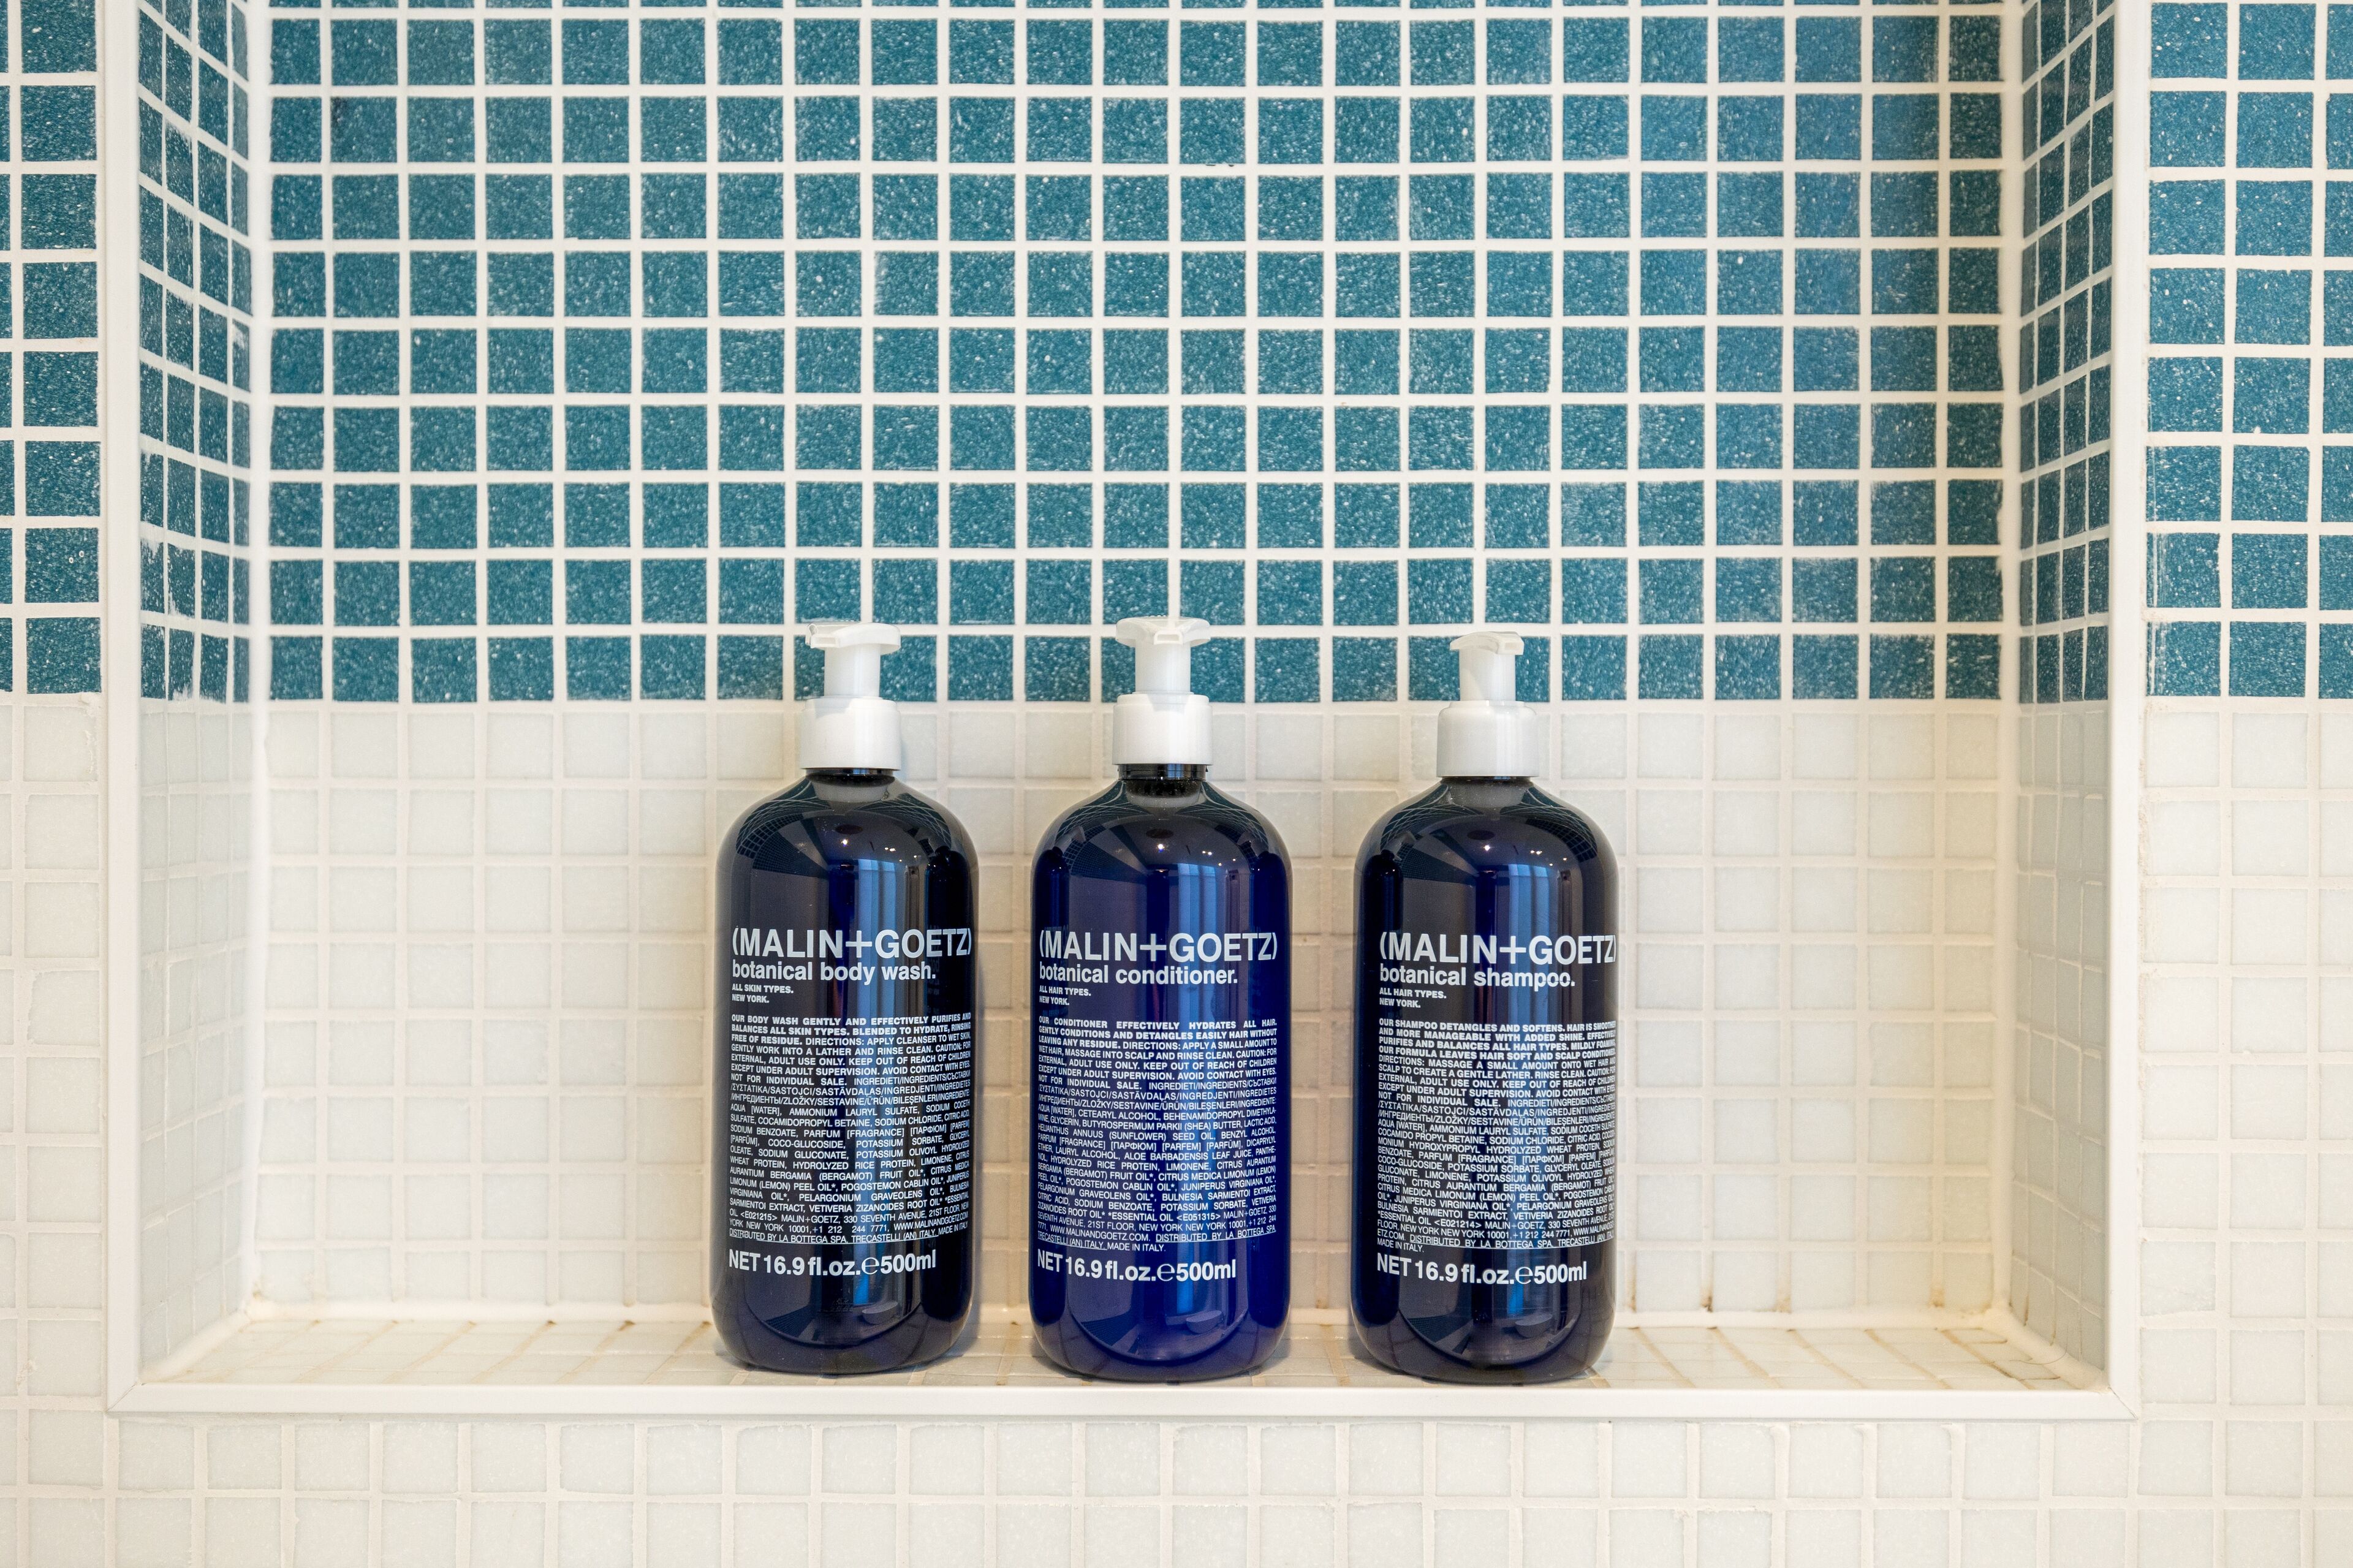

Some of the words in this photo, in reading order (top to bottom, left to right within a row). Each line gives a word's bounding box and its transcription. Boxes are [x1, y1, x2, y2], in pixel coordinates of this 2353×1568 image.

[732, 928, 972, 958] (MALIN+GOETZ)
[1039, 930, 1277, 963] (MALIN+GOETZ)
[1380, 932, 1616, 965] (MALIN+GOETZ)
[732, 960, 813, 980] botanical
[820, 961, 875, 985] body
[881, 960, 936, 980] wash.
[1039, 961, 1108, 983] botanical
[1115, 966, 1238, 985] conditioner.
[1380, 964, 1466, 985] botanical
[1474, 968, 1575, 991] shampoo.
[744, 984, 762, 993] SKIN
[763, 985, 794, 994] TYPES.
[1064, 987, 1091, 996] TYPES.
[1393, 988, 1412, 997] HAIR
[1414, 990, 1446, 999] TYPES.
[1039, 996, 1049, 1004] NEW
[1050, 996, 1069, 1006] YORK.
[1396, 999, 1421, 1008] YORK.
[731, 1014, 745, 1023] OUR
[747, 1015, 768, 1024] BODY
[772, 1016, 798, 1025] WASH
[802, 1017, 841, 1026] GENTLY
[871, 1015, 928, 1025] EFFECTIVELY
[931, 1013, 960, 1023] PURIFIES
[1039, 1015, 1049, 1024] OUR
[1053, 1017, 1107, 1028] CONDITIONER
[1116, 1021, 1180, 1029] EFFECTIVELY
[1189, 1021, 1236, 1029] HYDRATES
[1243, 1020, 1256, 1028] ALL
[1379, 1018, 1393, 1027] OUR
[1395, 1020, 1438, 1030] SHAMPOO
[1439, 1022, 1498, 1032] DETANGLES
[1522, 1024, 1565, 1032] SOFTENS.
[1566, 1023, 1585, 1032] HAIR
[731, 1023, 768, 1034] BALANCES
[770, 1026, 786, 1035] ALL
[788, 1027, 811, 1036] SKIN
[852, 1027, 897, 1036] BLENDED
[913, 1024, 950, 1035] HYDRATE,
[1039, 1025, 1059, 1036] GENTLY
[1060, 1028, 1110, 1039] CONDITIONS
[1113, 1031, 1133, 1040] AND
[1195, 1031, 1227, 1039] EASILY
[1229, 1029, 1248, 1039] HAIR
[1249, 1028, 1277, 1037] WITHOUT
[1379, 1027, 1393, 1036] AND
[1396, 1029, 1420, 1038] MORE
[1424, 1031, 1491, 1041] MANAGEABLE
[1559, 1032, 1585, 1040] SHINE.
[731, 1034, 747, 1042] FREE
[748, 1035, 759, 1043] OF
[760, 1036, 802, 1045] RESIDUE.
[866, 1037, 894, 1045] APPLY
[896, 1035, 936, 1045] CLEANSER
[938, 1034, 947, 1042] TO
[948, 1032, 960, 1042] WET
[1038, 1054, 1067, 1067] EXTERNAL,
[1069, 1058, 1092, 1068] ADULT
[1095, 1061, 1112, 1069] USE
[1115, 1061, 1140, 1070] ONLY.
[1207, 1060, 1235, 1069] REACH
[1249, 1057, 1276, 1067] CHILDREN
[1379, 1054, 1424, 1067] DIRECTIONS:
[1428, 1059, 1472, 1069] MASSAGE
[1487, 1061, 1517, 1070] SMALL
[1522, 1061, 1556, 1070] AMOUNT
[1561, 1060, 1581, 1069] ONTO
[1583, 1059, 1596, 1068] WET
[730, 1124, 752, 1134] SODIUM
[756, 1127, 798, 1138] BENZOATE,
[803, 1129, 840, 1138] PARFUM
[847, 1128, 904, 1138] [FRAGRANCE]
[1072, 1128, 1103, 1138] ANNUUS
[1109, 1131, 1166, 1142] (SUNFLOWER)
[1172, 1132, 1195, 1141] SEED
[1200, 1132, 1216, 1141] OIL,
[1221, 1130, 1248, 1139] BENZYL
[1055, 1145, 1078, 1156] LAURYL
[1081, 1149, 1120, 1161] ALCOHOL,
[1124, 1152, 1146, 1161] ALOE
[1150, 1152, 1208, 1161] BARBADENSIS
[1212, 1151, 1230, 1159] LEAF
[1233, 1149, 1253, 1159] JUICE,
[1064, 1167, 1107, 1180] (BERGAMOT)
[1110, 1172, 1131, 1181] FRUIT
[1191, 1172, 1221, 1181] MEDICA
[1223, 1168, 1254, 1179] LIMONUM
[1377, 1164, 1419, 1179] GLUCONATE,
[1425, 1171, 1471, 1182] LIMONENE,
[1477, 1174, 1526, 1183] POTASSIUM
[1531, 1173, 1563, 1183] OLIVOYL
[1567, 1168, 1603, 1181] HYDROLYZED
[730, 1176, 757, 1188] LIMONUM
[759, 1181, 790, 1192] (LEMON)
[841, 1181, 901, 1191] POGOSTEMON
[903, 1178, 929, 1189] CABLIN
[1377, 1182, 1400, 1194] CITRUS
[1402, 1186, 1432, 1197] MEDICA
[1435, 1190, 1476, 1200] LIMONUM
[1479, 1192, 1516, 1202] (LEMON)
[1563, 1187, 1603, 1200] POGOSTEMON
[729, 1249, 761, 1272] NET
[763, 1255, 805, 1276] 16.9
[1038, 1249, 1063, 1272] NET
[1065, 1256, 1102, 1278] 16.9
[1377, 1252, 1412, 1277] NET
[1415, 1260, 1458, 1282] 16.9
